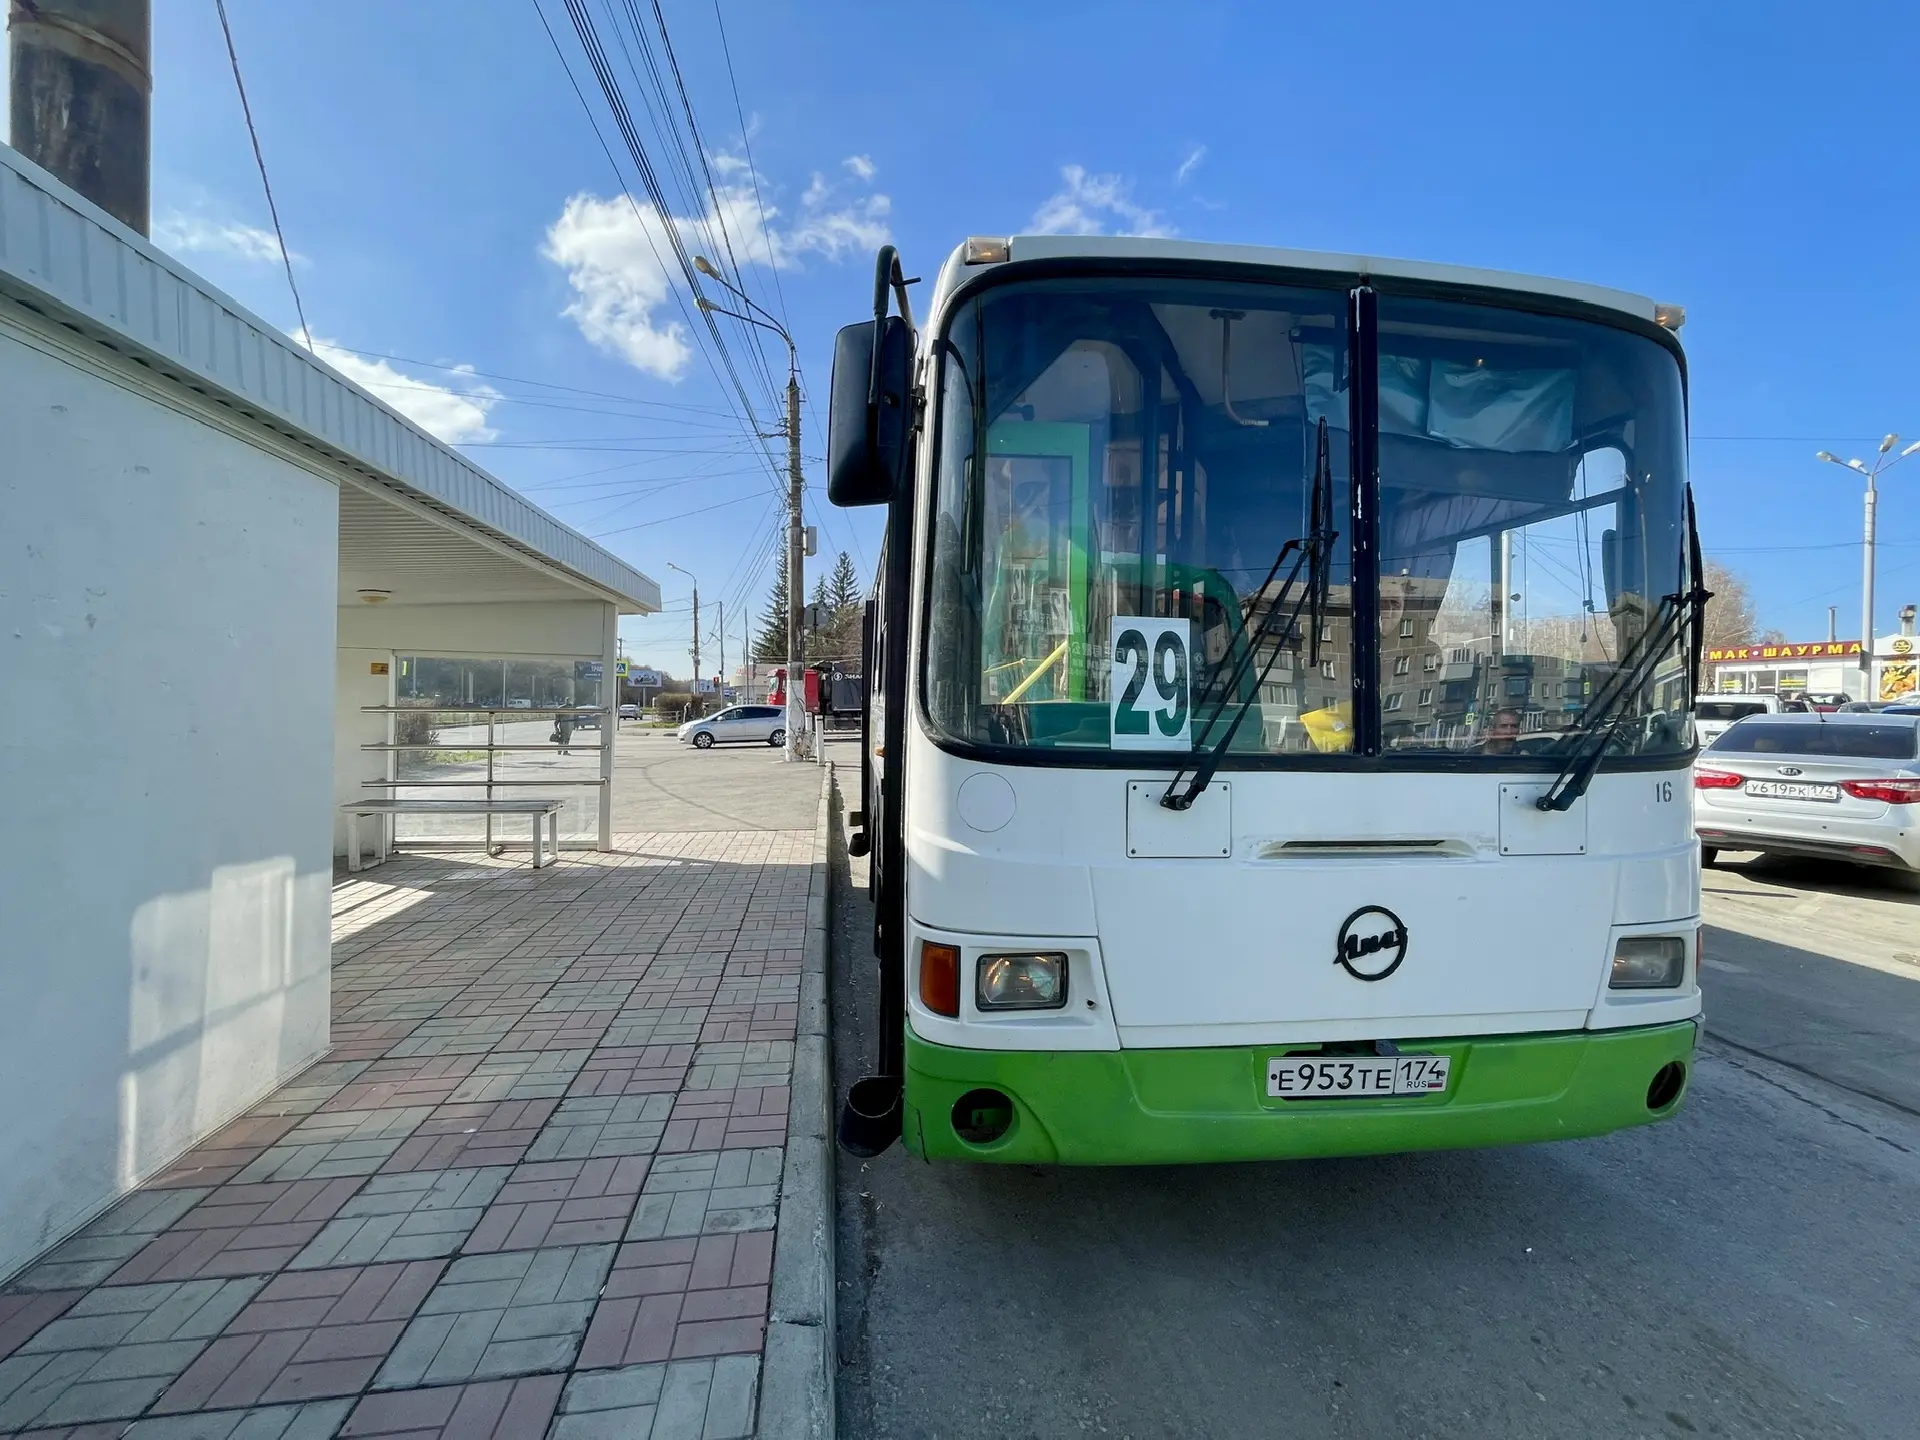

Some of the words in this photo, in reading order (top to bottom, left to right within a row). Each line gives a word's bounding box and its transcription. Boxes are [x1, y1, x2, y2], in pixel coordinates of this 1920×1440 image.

[1709, 649, 1748, 660] МАК
[1763, 643, 1862, 657] ШАУРМА
[1115, 628, 1188, 737] 29
[1781, 767, 1799, 775] KIA
[1655, 780, 1673, 803] 16
[1278, 1063, 1391, 1091] Е953ТЕ
[1401, 1060, 1440, 1080] 174
[1406, 1080, 1427, 1088] RUS
